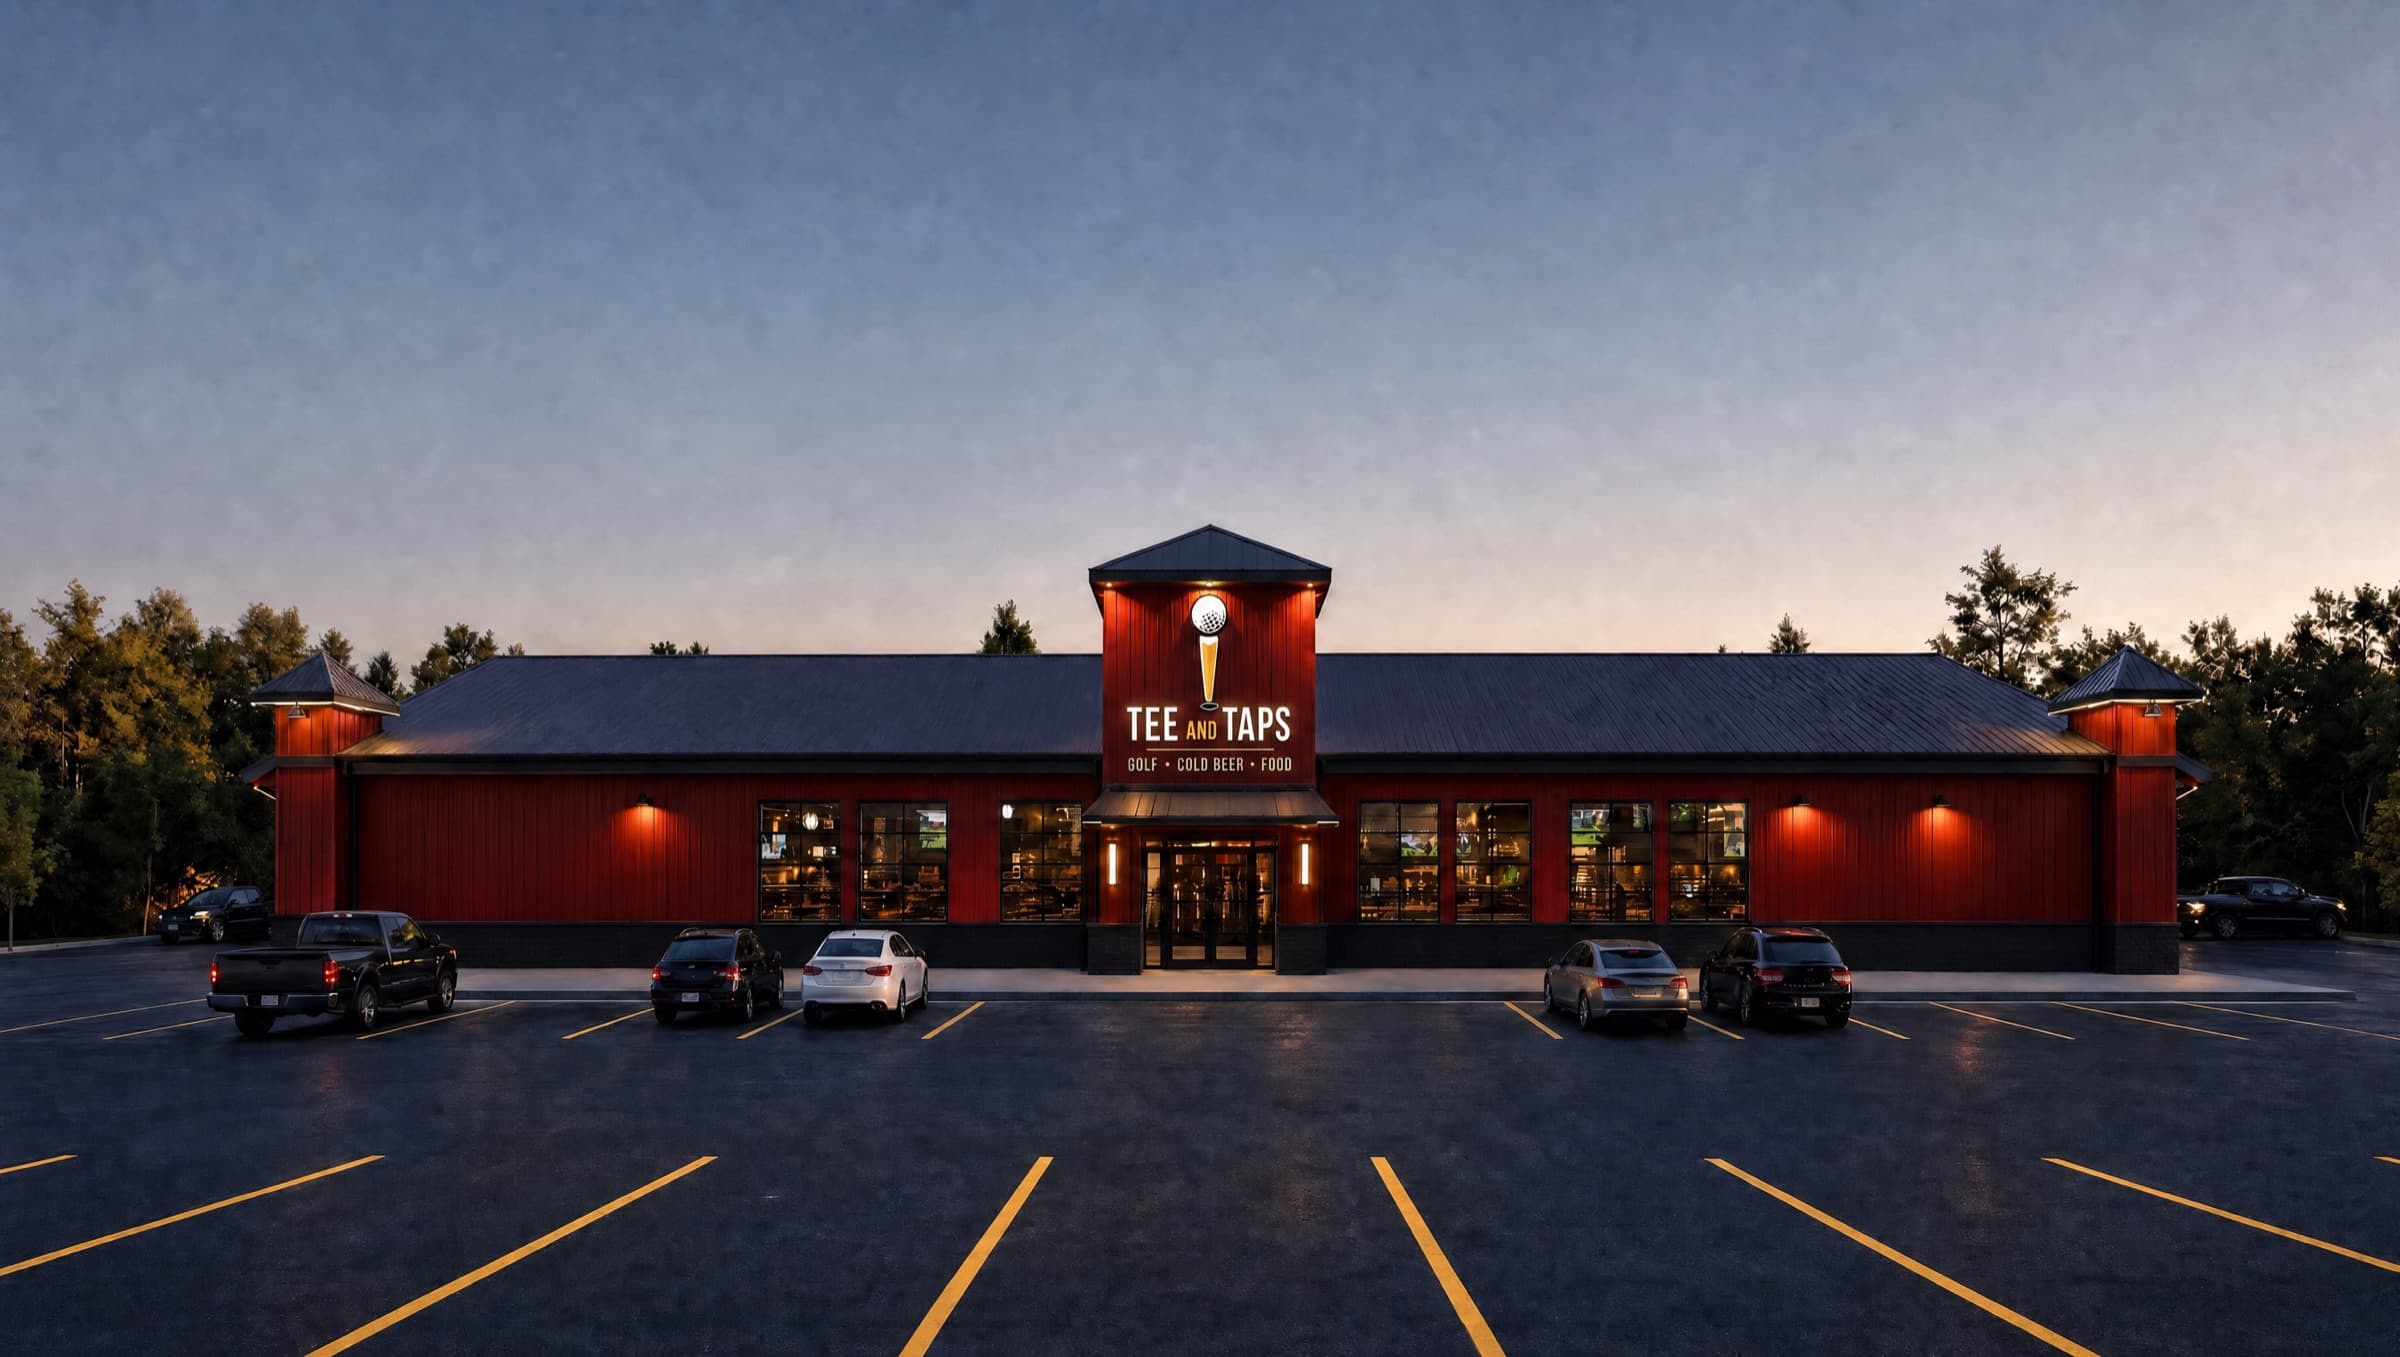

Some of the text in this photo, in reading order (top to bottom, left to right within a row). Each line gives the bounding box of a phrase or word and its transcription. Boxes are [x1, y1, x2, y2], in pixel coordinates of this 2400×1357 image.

[1126, 706, 1291, 742] TEE AND TAPS
[1127, 757, 1292, 772] GOLF COLD BEER FOOD
